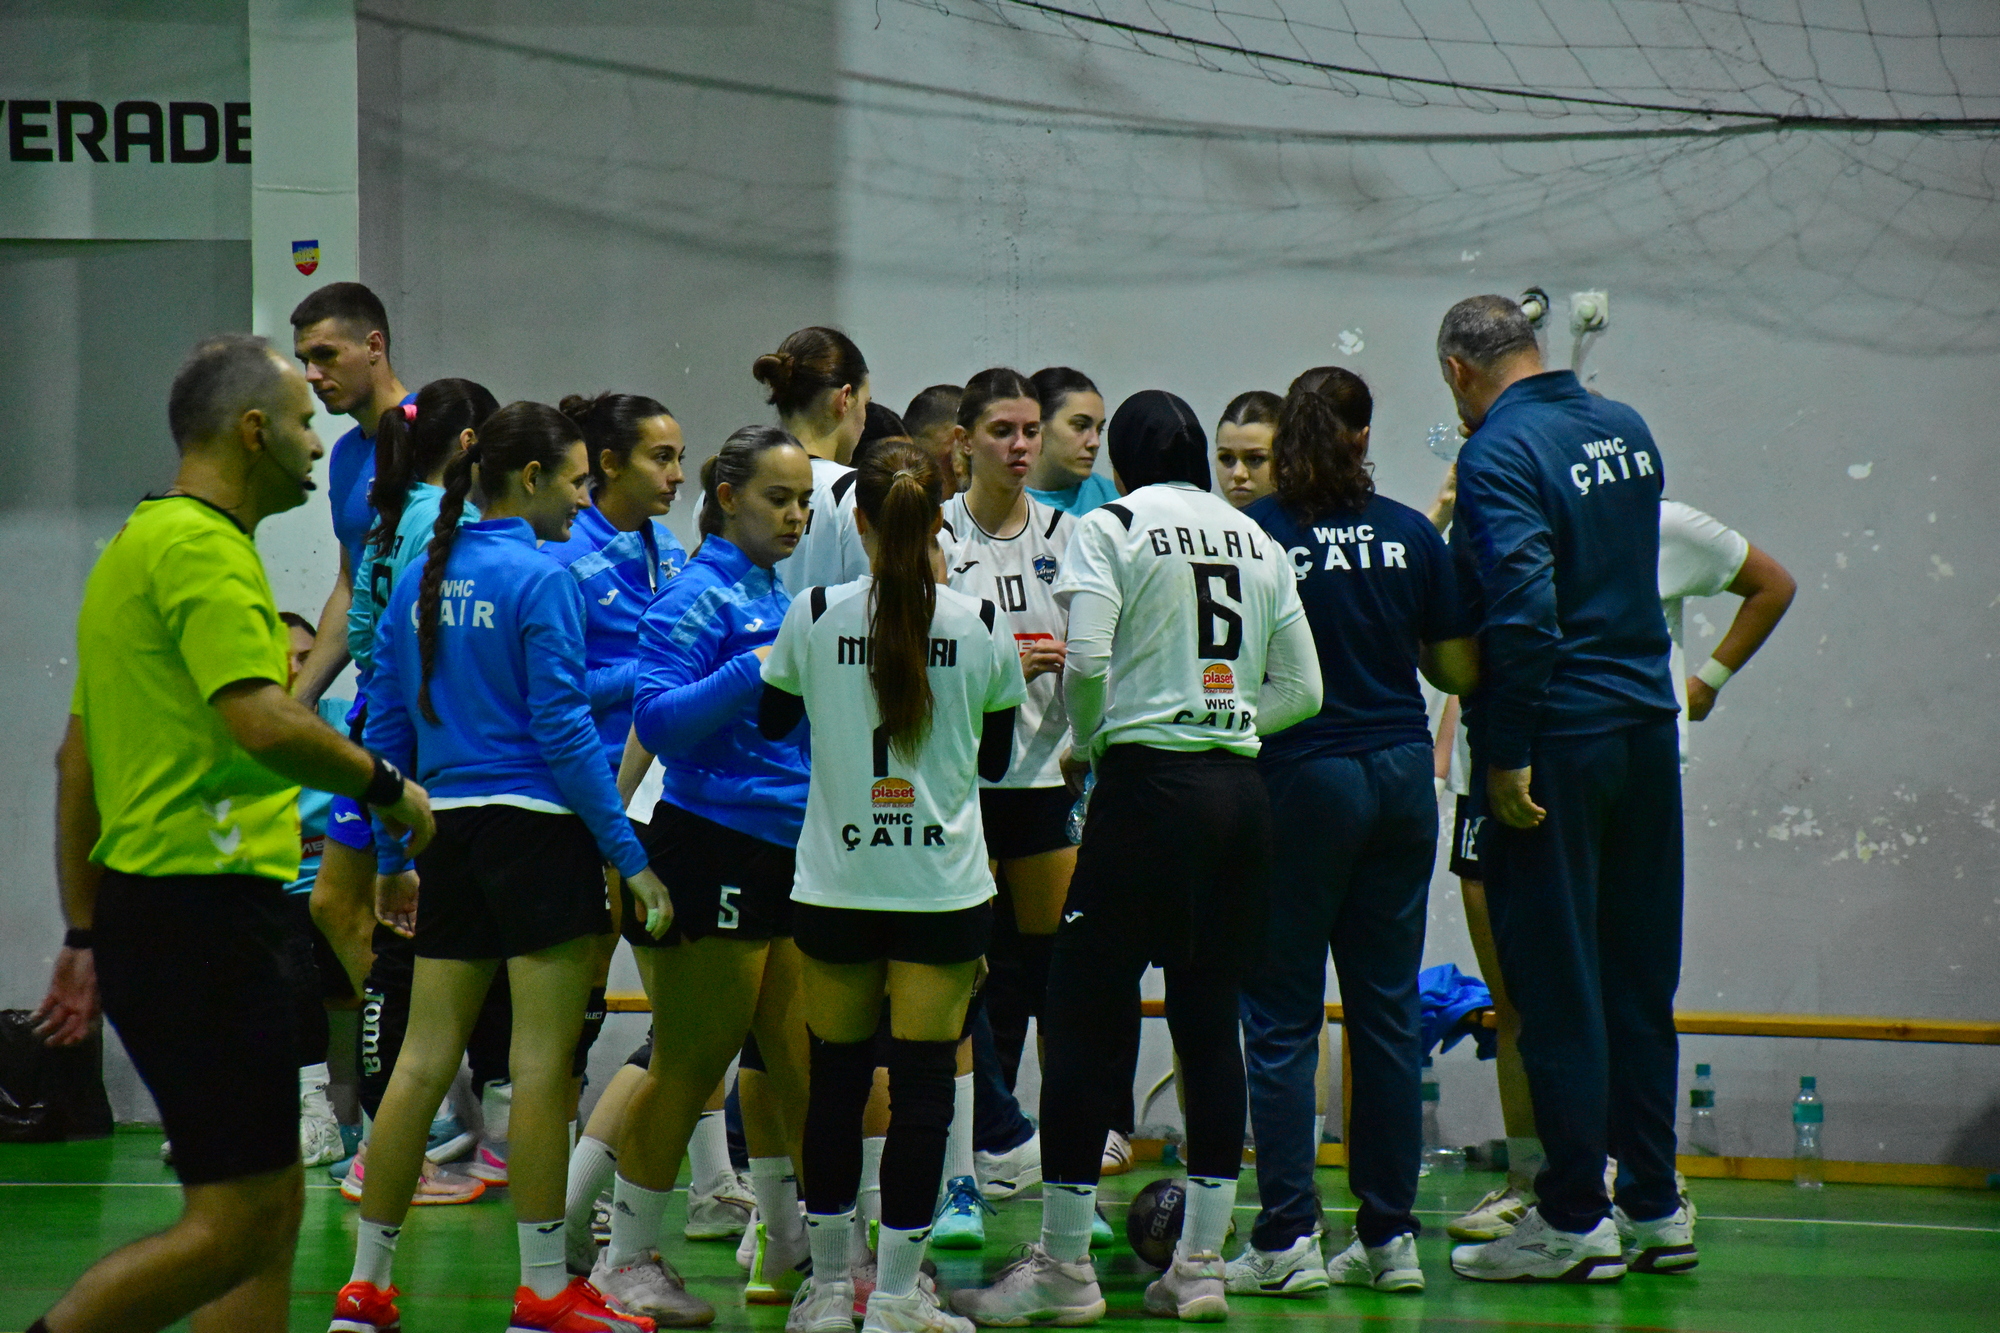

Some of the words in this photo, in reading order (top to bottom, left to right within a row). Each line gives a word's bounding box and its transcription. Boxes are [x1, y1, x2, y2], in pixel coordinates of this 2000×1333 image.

[0, 100, 252, 164] ERADE
[1582, 436, 1627, 459] WHC
[1570, 450, 1654, 496] ÇAIR
[1147, 526, 1264, 560] GALAL
[1313, 524, 1375, 544] WHC
[1286, 541, 1407, 580] ÇAIR
[995, 574, 1027, 612] 10
[1188, 562, 1243, 661] 6
[1203, 671, 1234, 685] plaset
[1205, 699, 1235, 710] WHC
[871, 786, 915, 800] plaset
[873, 813, 913, 825] WHC
[842, 824, 945, 851] ÇAIR
[718, 885, 741, 929] 5
[585, 1011, 603, 1020] ELECT
[1151, 1187, 1181, 1237] SELECT
